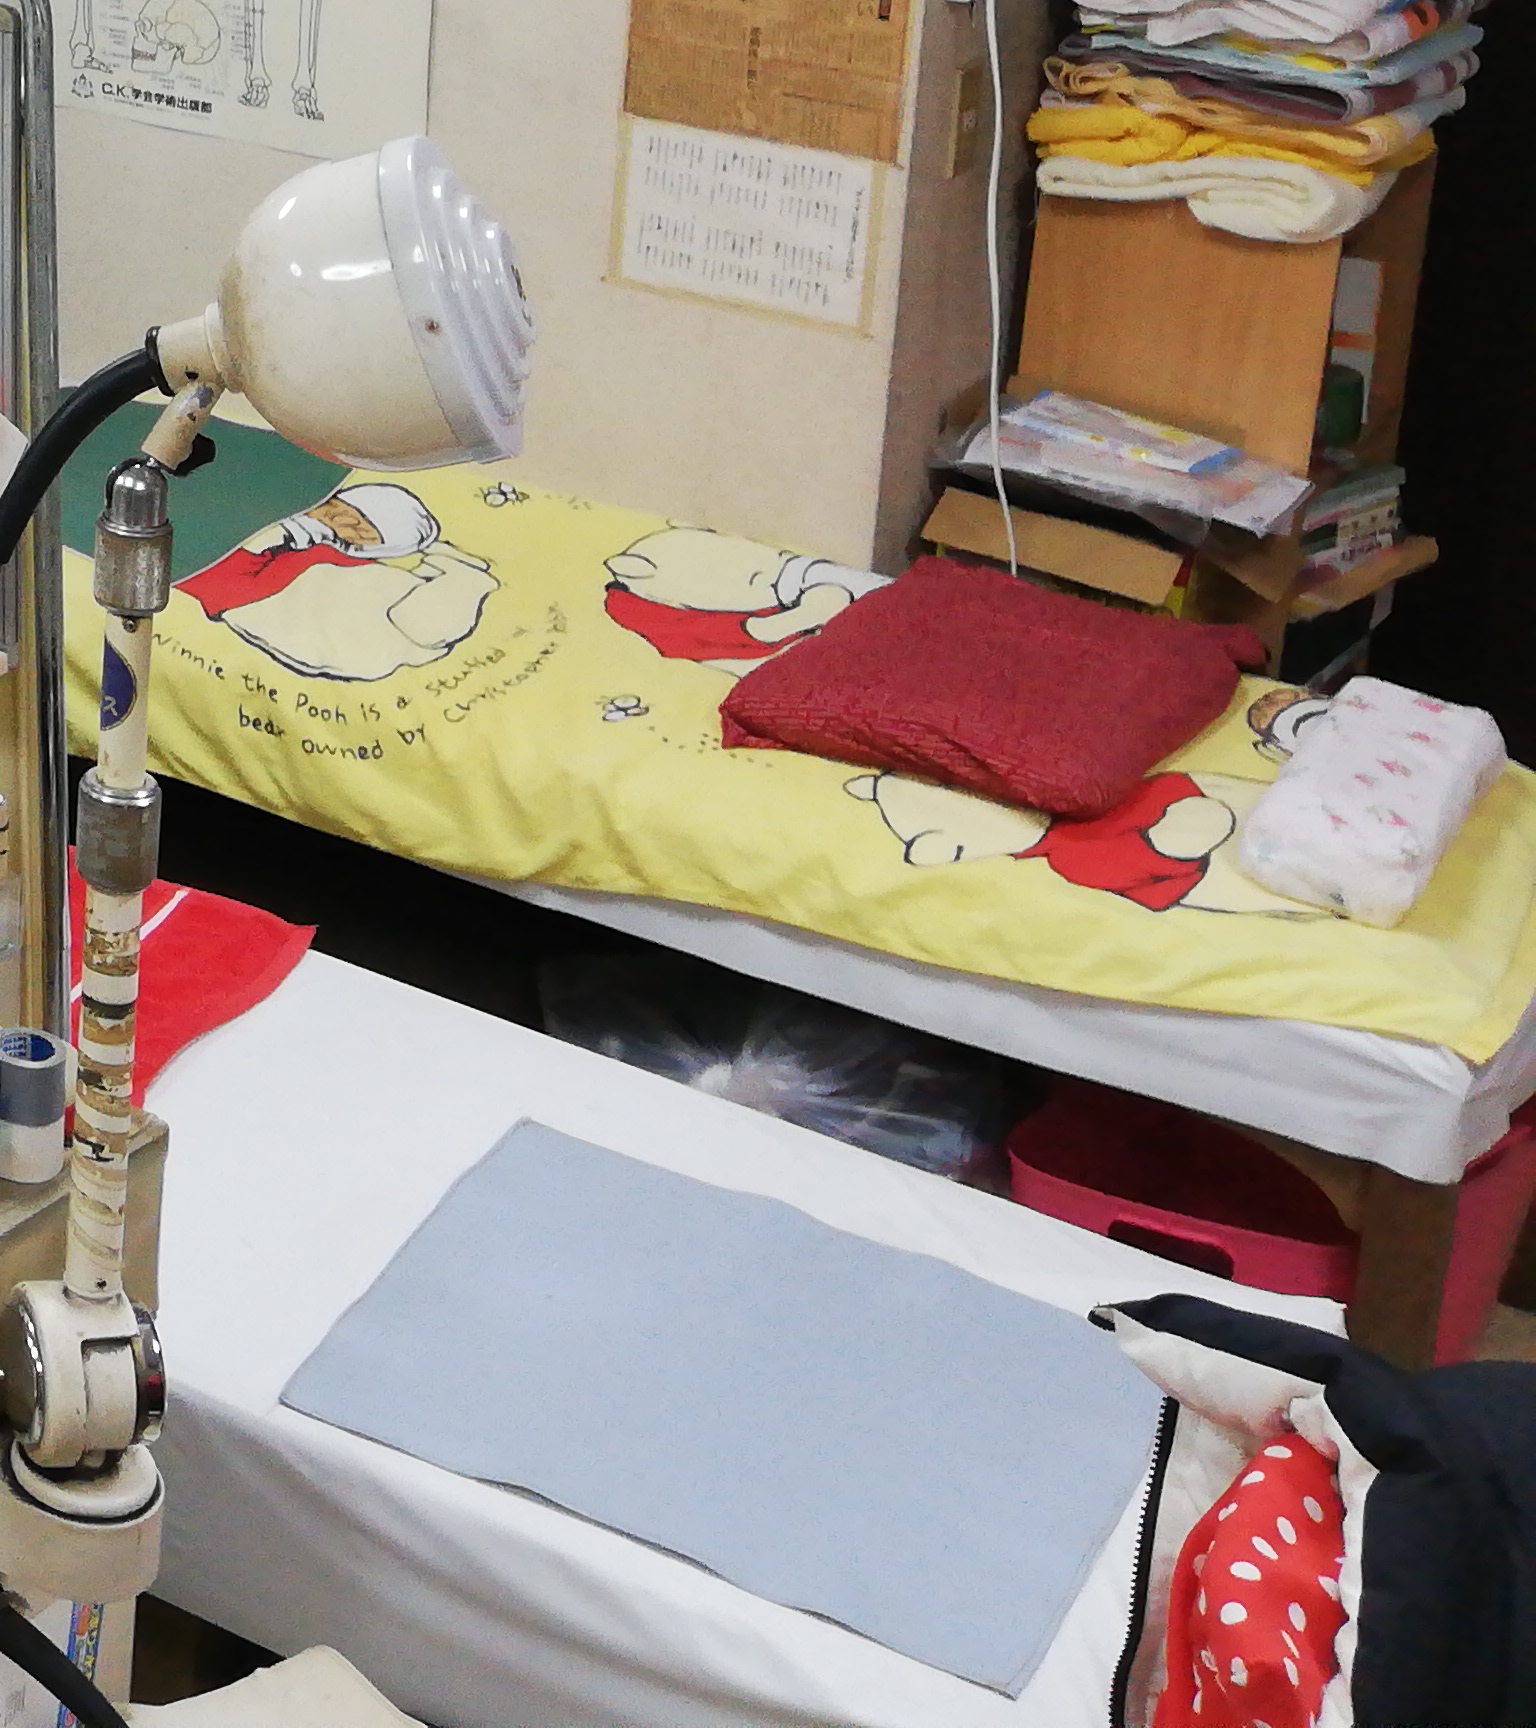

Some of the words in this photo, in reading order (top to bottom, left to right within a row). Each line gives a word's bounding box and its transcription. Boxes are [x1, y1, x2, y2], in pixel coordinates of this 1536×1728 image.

[241, 673, 278, 704] the
[295, 692, 348, 725] Pooh
[238, 705, 286, 739] bear
[301, 737, 385, 761] owned
